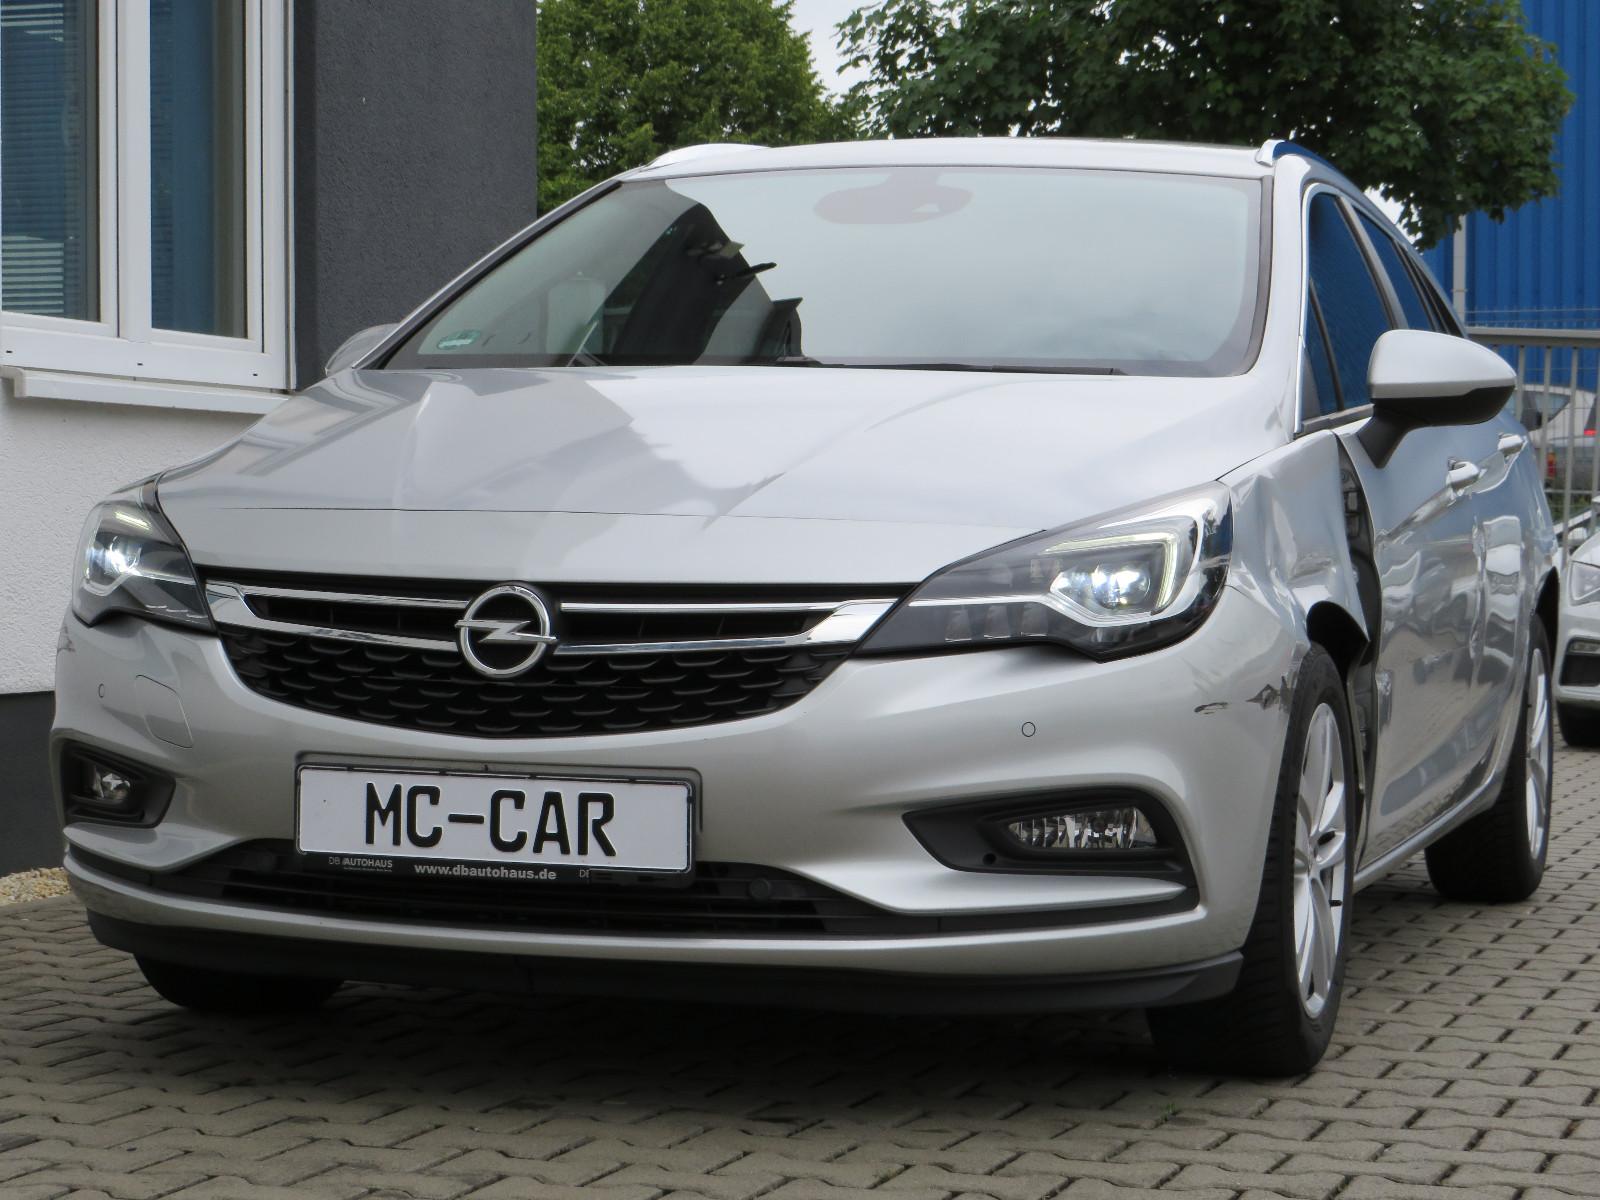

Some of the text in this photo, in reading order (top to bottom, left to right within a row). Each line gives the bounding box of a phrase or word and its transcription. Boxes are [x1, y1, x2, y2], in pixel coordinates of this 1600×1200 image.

[365, 782, 617, 857] MC-CAR
[342, 857, 393, 868] AUTOHAUS
[414, 864, 557, 880] www.dbautohaus.de
